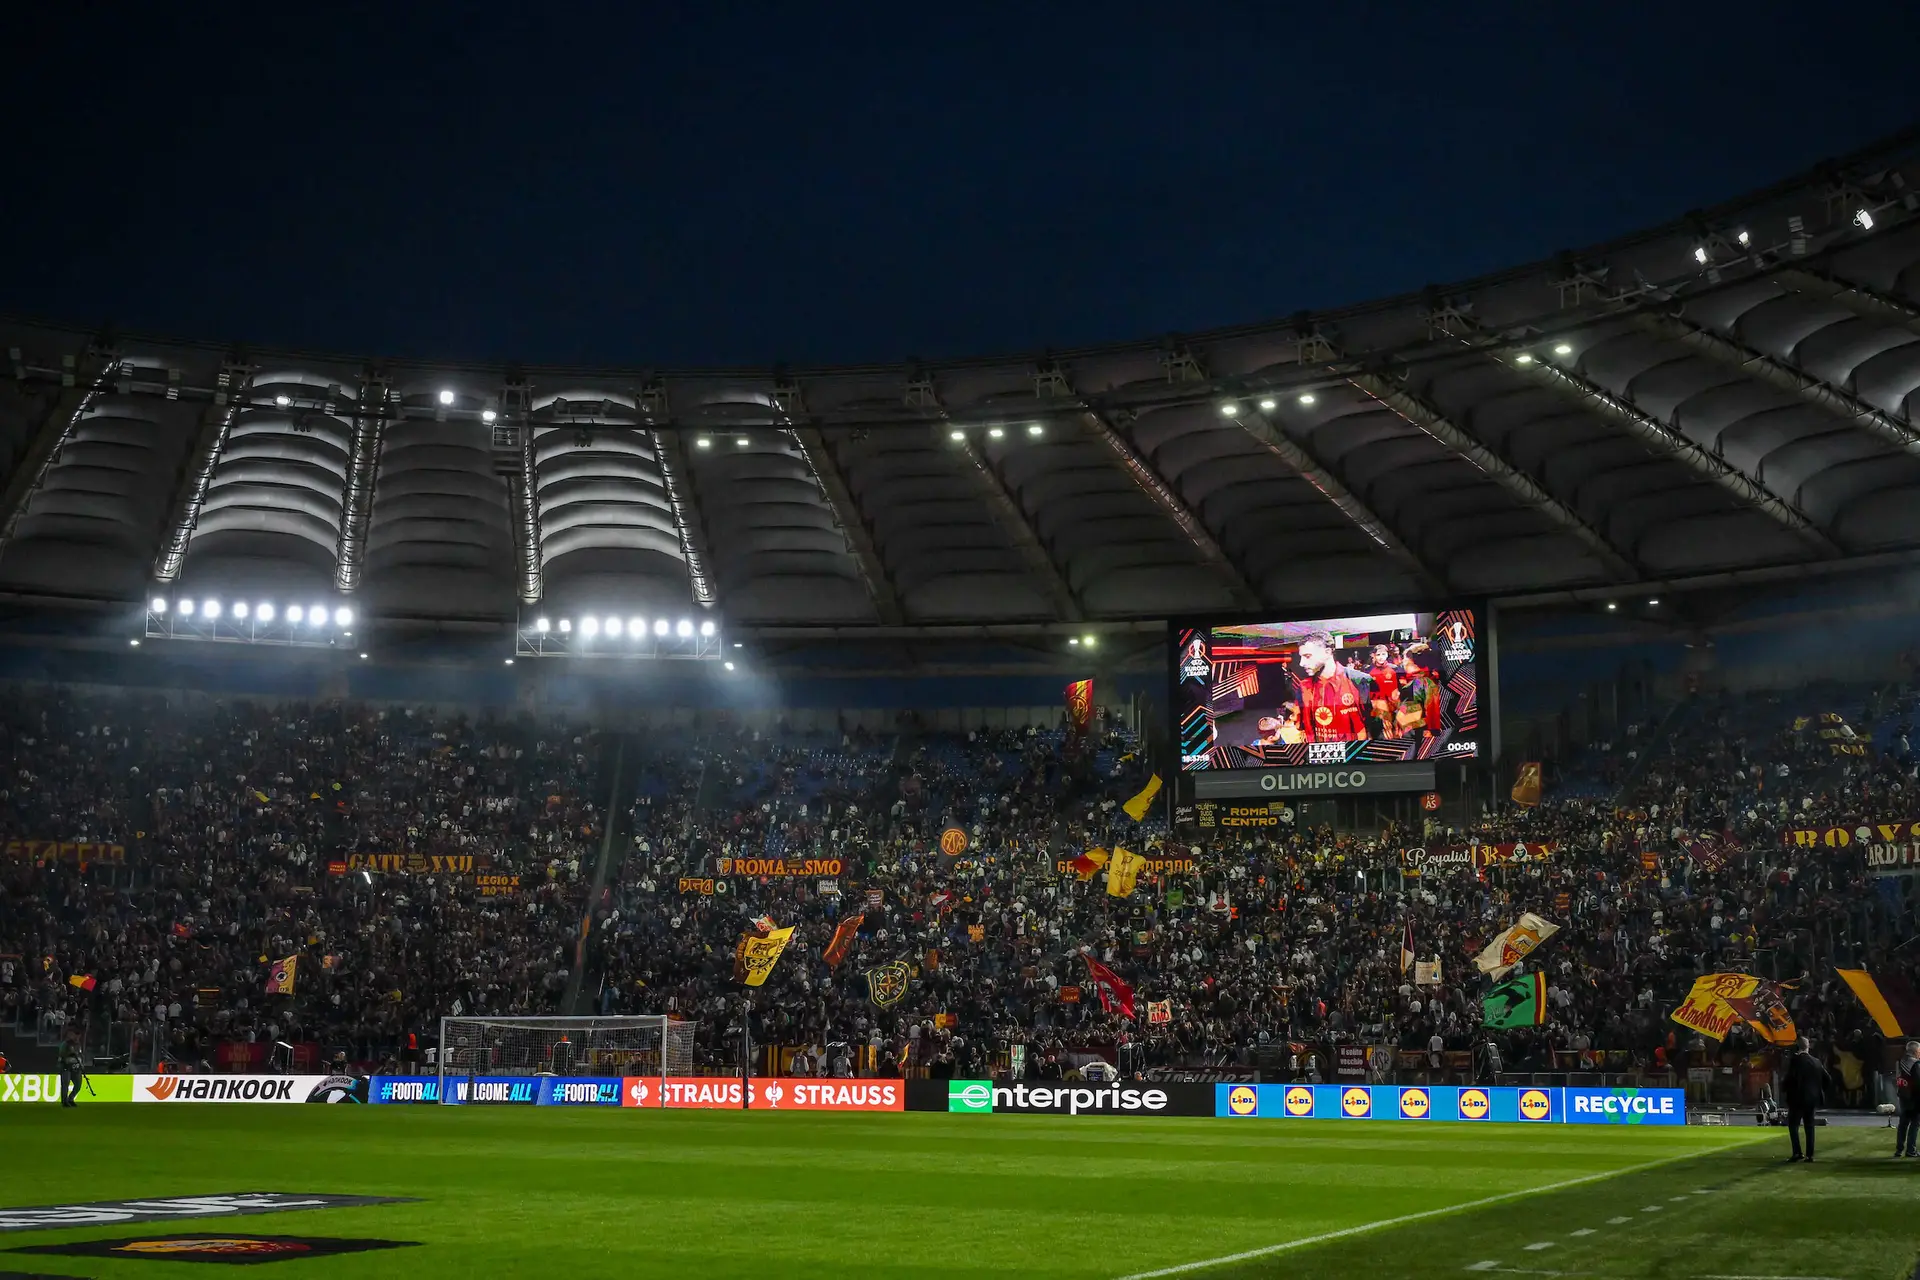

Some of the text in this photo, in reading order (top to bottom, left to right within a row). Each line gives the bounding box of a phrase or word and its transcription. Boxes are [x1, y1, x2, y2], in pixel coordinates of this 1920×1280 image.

[1309, 743, 1346, 753] LEAGUE
[1447, 742, 1476, 751] 00:08
[1260, 771, 1366, 791] OLIMPICO
[1230, 807, 1269, 816] ROMA
[1221, 817, 1279, 826] CENTRO
[457, 1083, 532, 1101] WLCOME ALL
[793, 1085, 896, 1105] STRAUSS
[1575, 1097, 1675, 1114] RECYCLE
